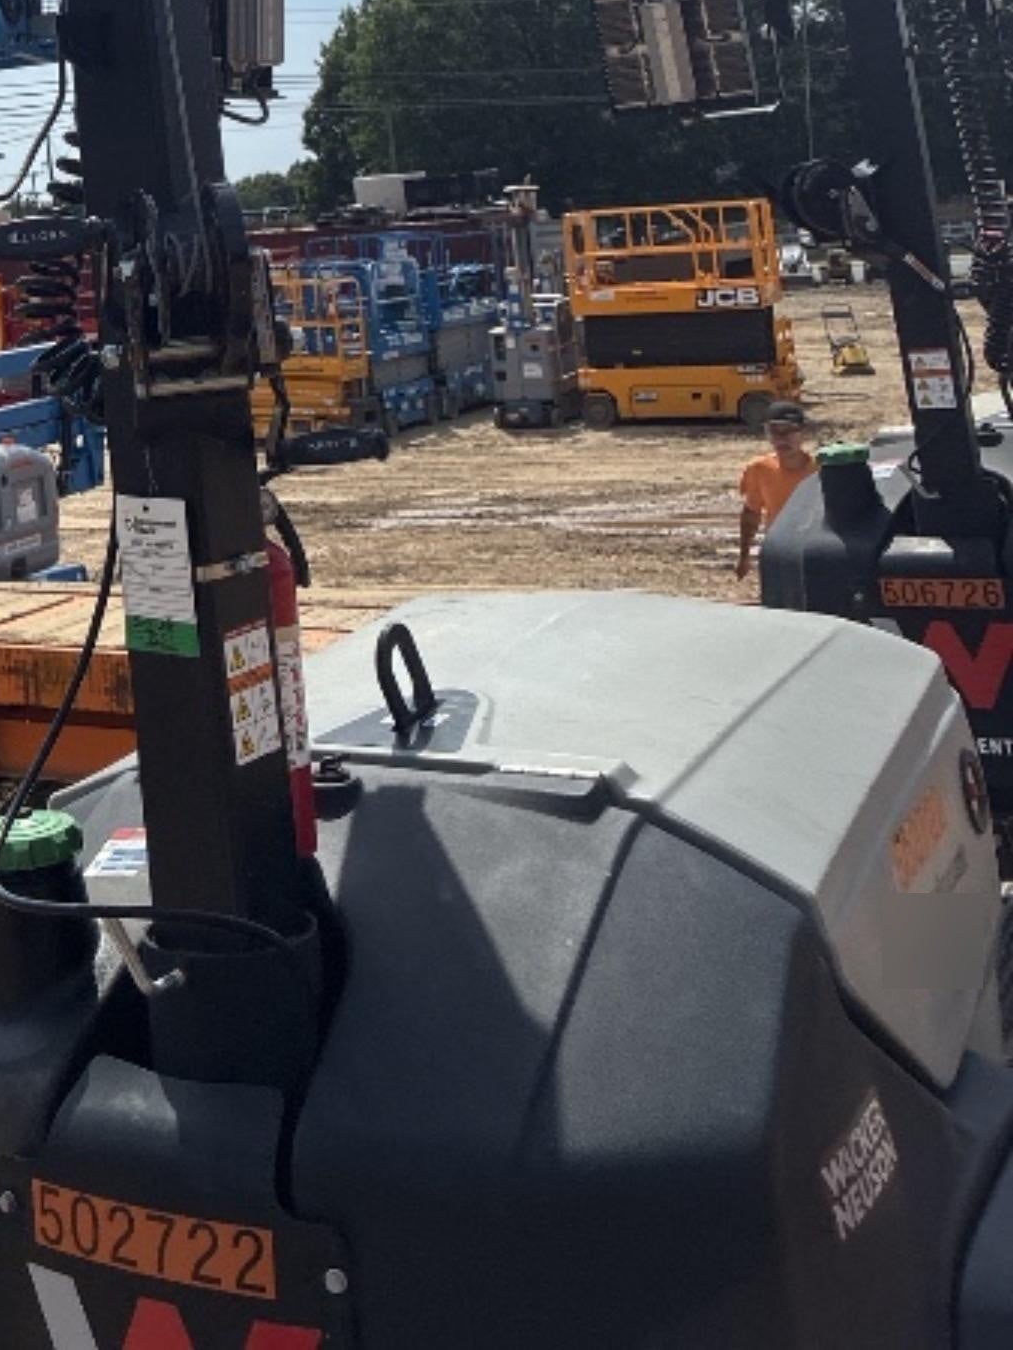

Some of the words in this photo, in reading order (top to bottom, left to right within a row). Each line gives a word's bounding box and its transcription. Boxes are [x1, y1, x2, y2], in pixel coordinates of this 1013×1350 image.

[697, 288, 760, 308] JCB
[883, 580, 1001, 607] 506726
[832, 1130, 898, 1241] NEUSON
[38, 1187, 269, 1295] 502722
